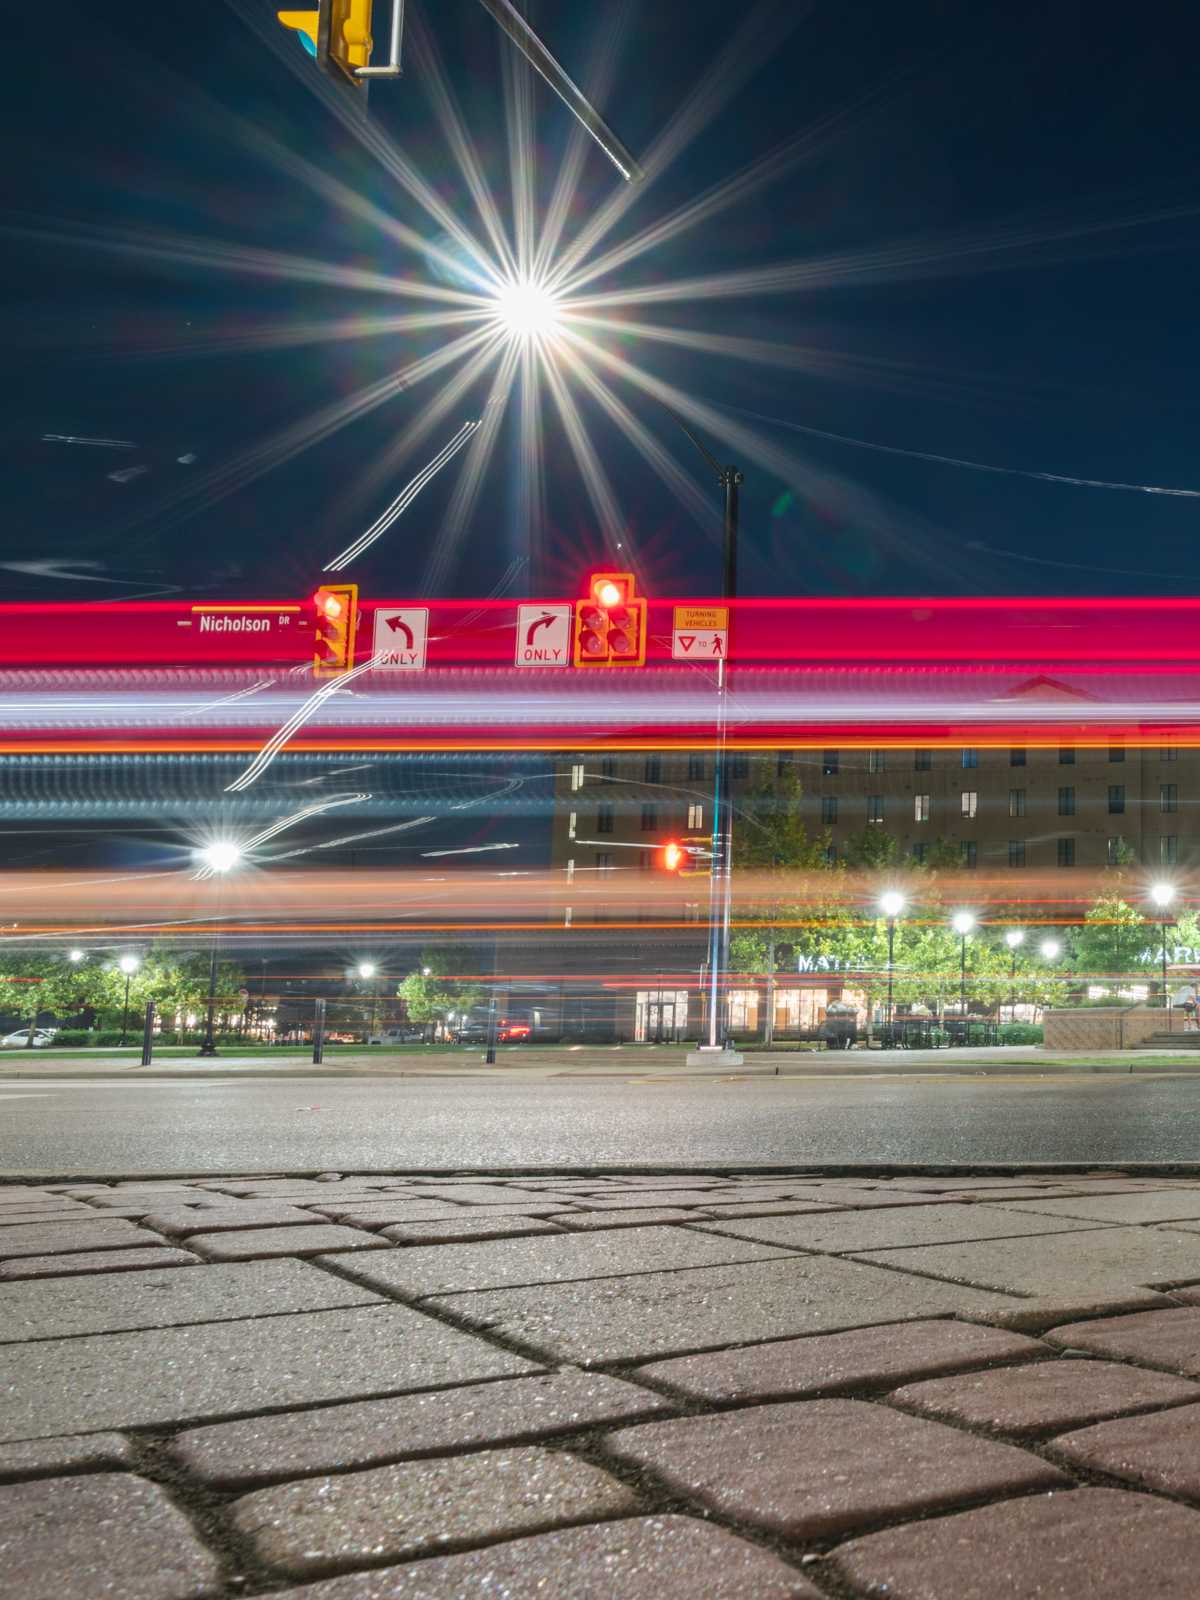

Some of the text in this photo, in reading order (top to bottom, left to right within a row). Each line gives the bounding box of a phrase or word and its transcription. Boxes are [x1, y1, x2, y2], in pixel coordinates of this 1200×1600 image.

[199, 615, 290, 633] Nicholson DR
[381, 654, 417, 665] ONLY
[524, 649, 561, 661] ONLY
